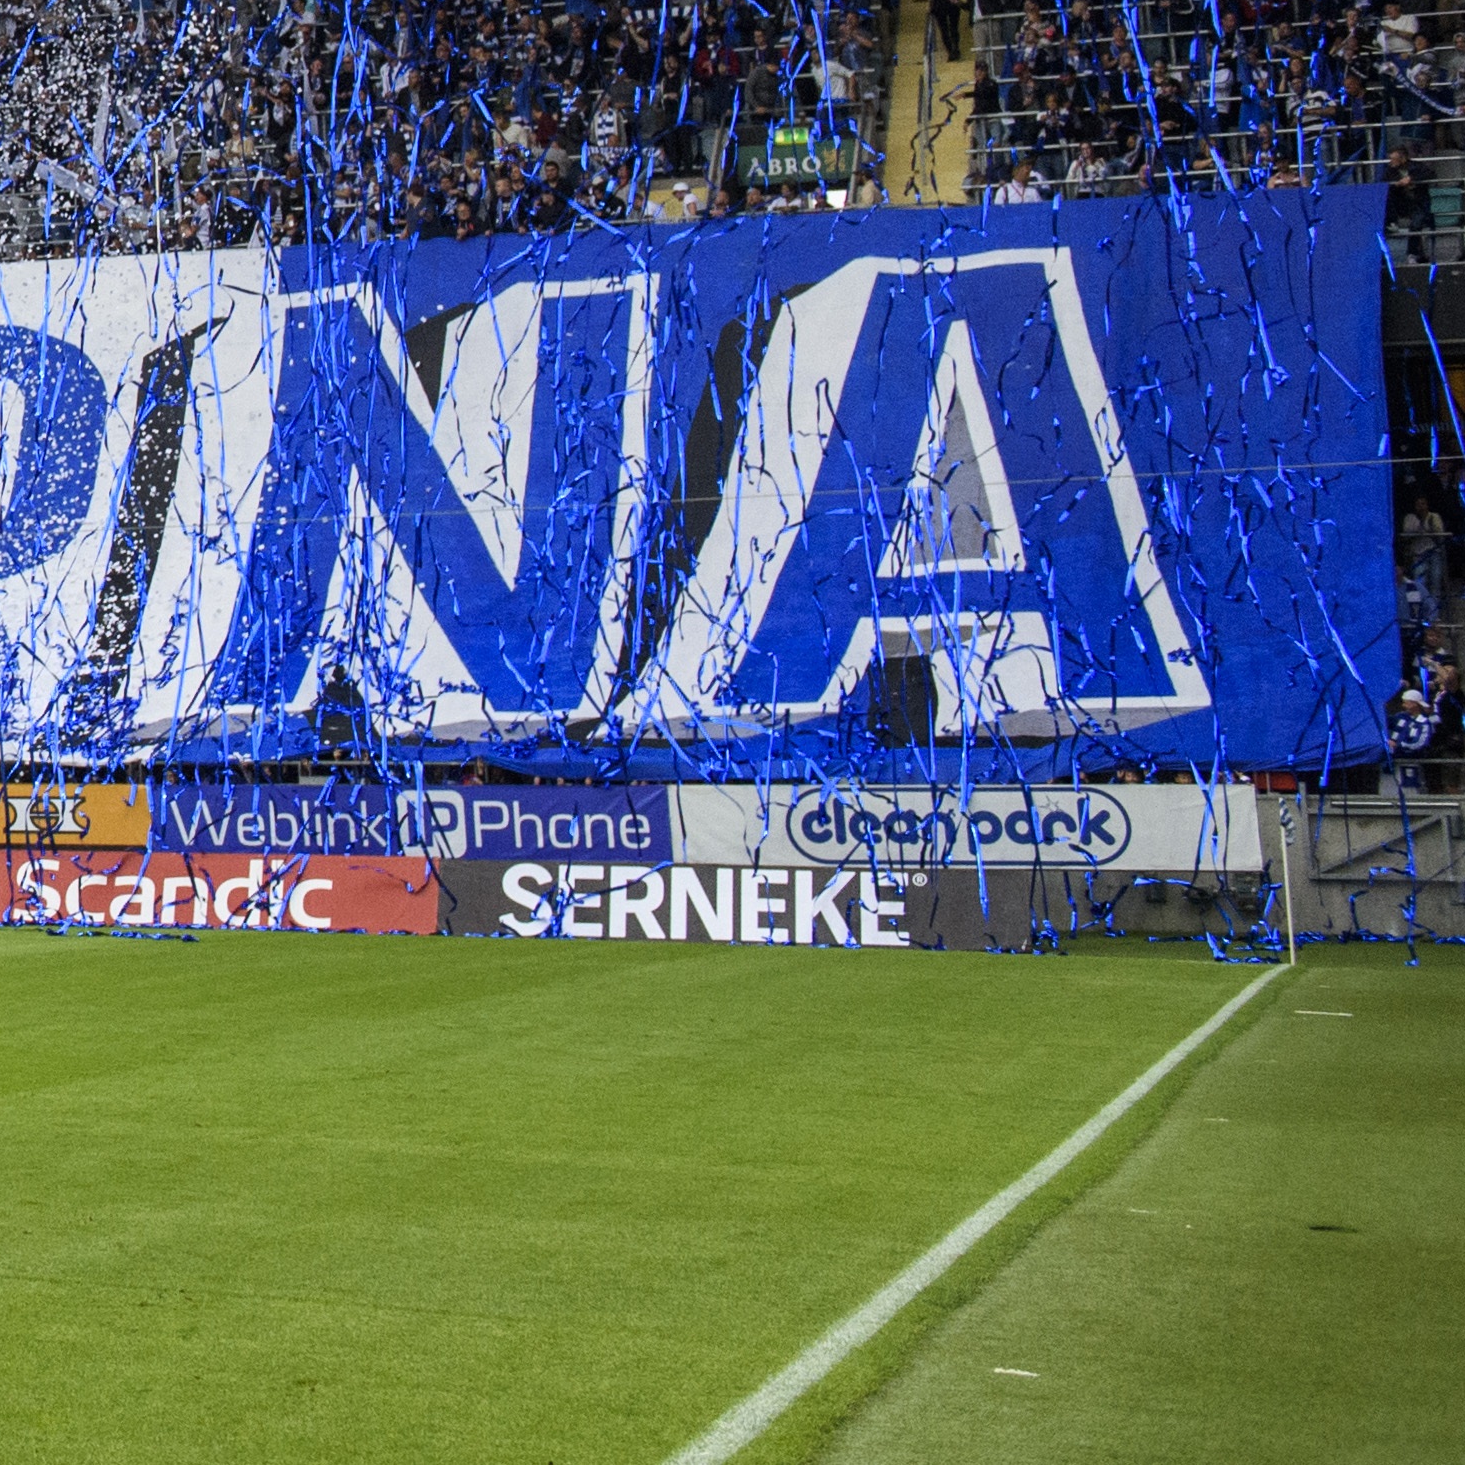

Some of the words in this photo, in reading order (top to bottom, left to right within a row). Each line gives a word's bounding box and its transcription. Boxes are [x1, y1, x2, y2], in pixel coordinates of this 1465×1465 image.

[170, 799, 388, 848] Weblink
[473, 799, 651, 851] Phone
[13, 857, 333, 927] Scandic
